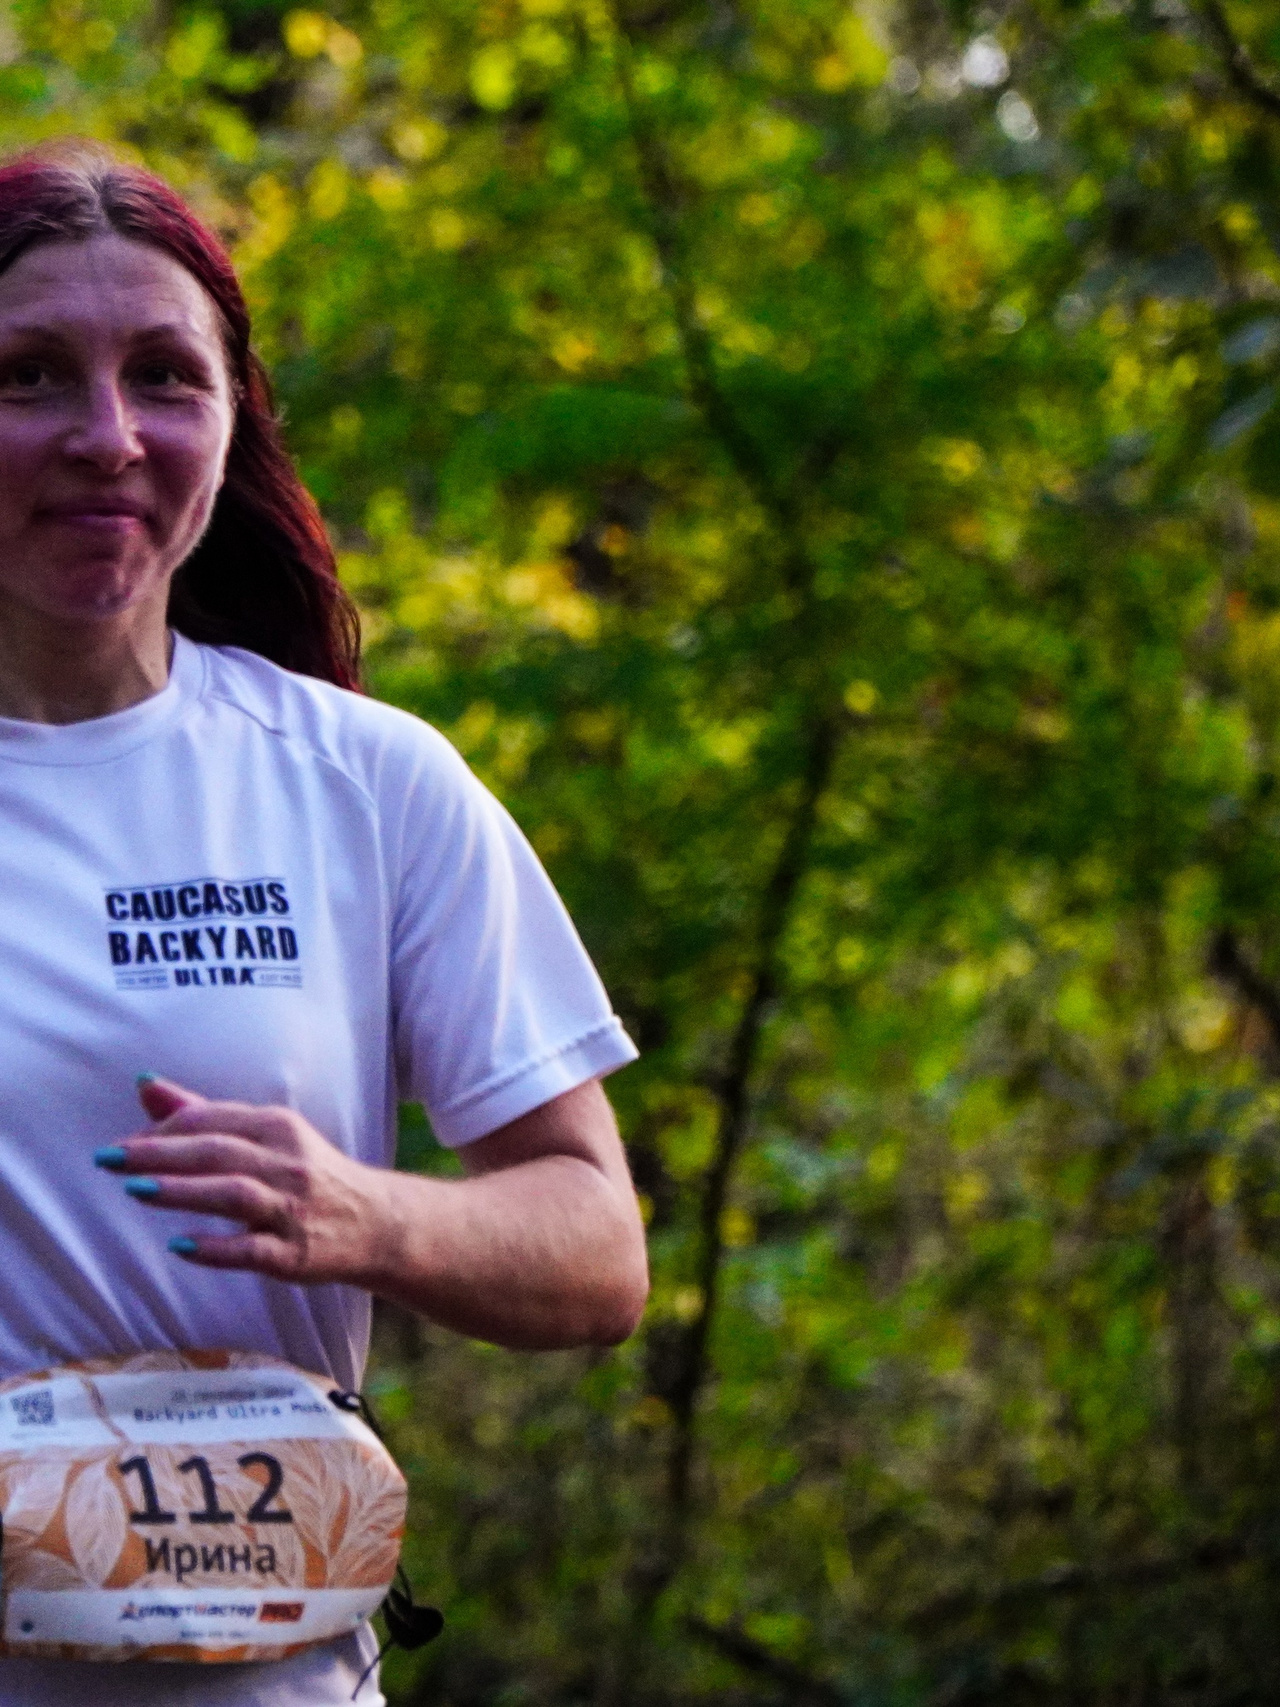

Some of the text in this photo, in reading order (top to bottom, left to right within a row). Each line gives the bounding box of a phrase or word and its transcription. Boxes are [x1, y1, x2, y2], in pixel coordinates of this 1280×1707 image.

[105, 882, 290, 921] CAUCASUS
[108, 926, 299, 965] BACKYARD
[174, 967, 256, 986] ULTRA
[227, 1404, 281, 1419] Ultra
[119, 1451, 293, 1524] 112
[145, 1539, 278, 1583] Ирина
